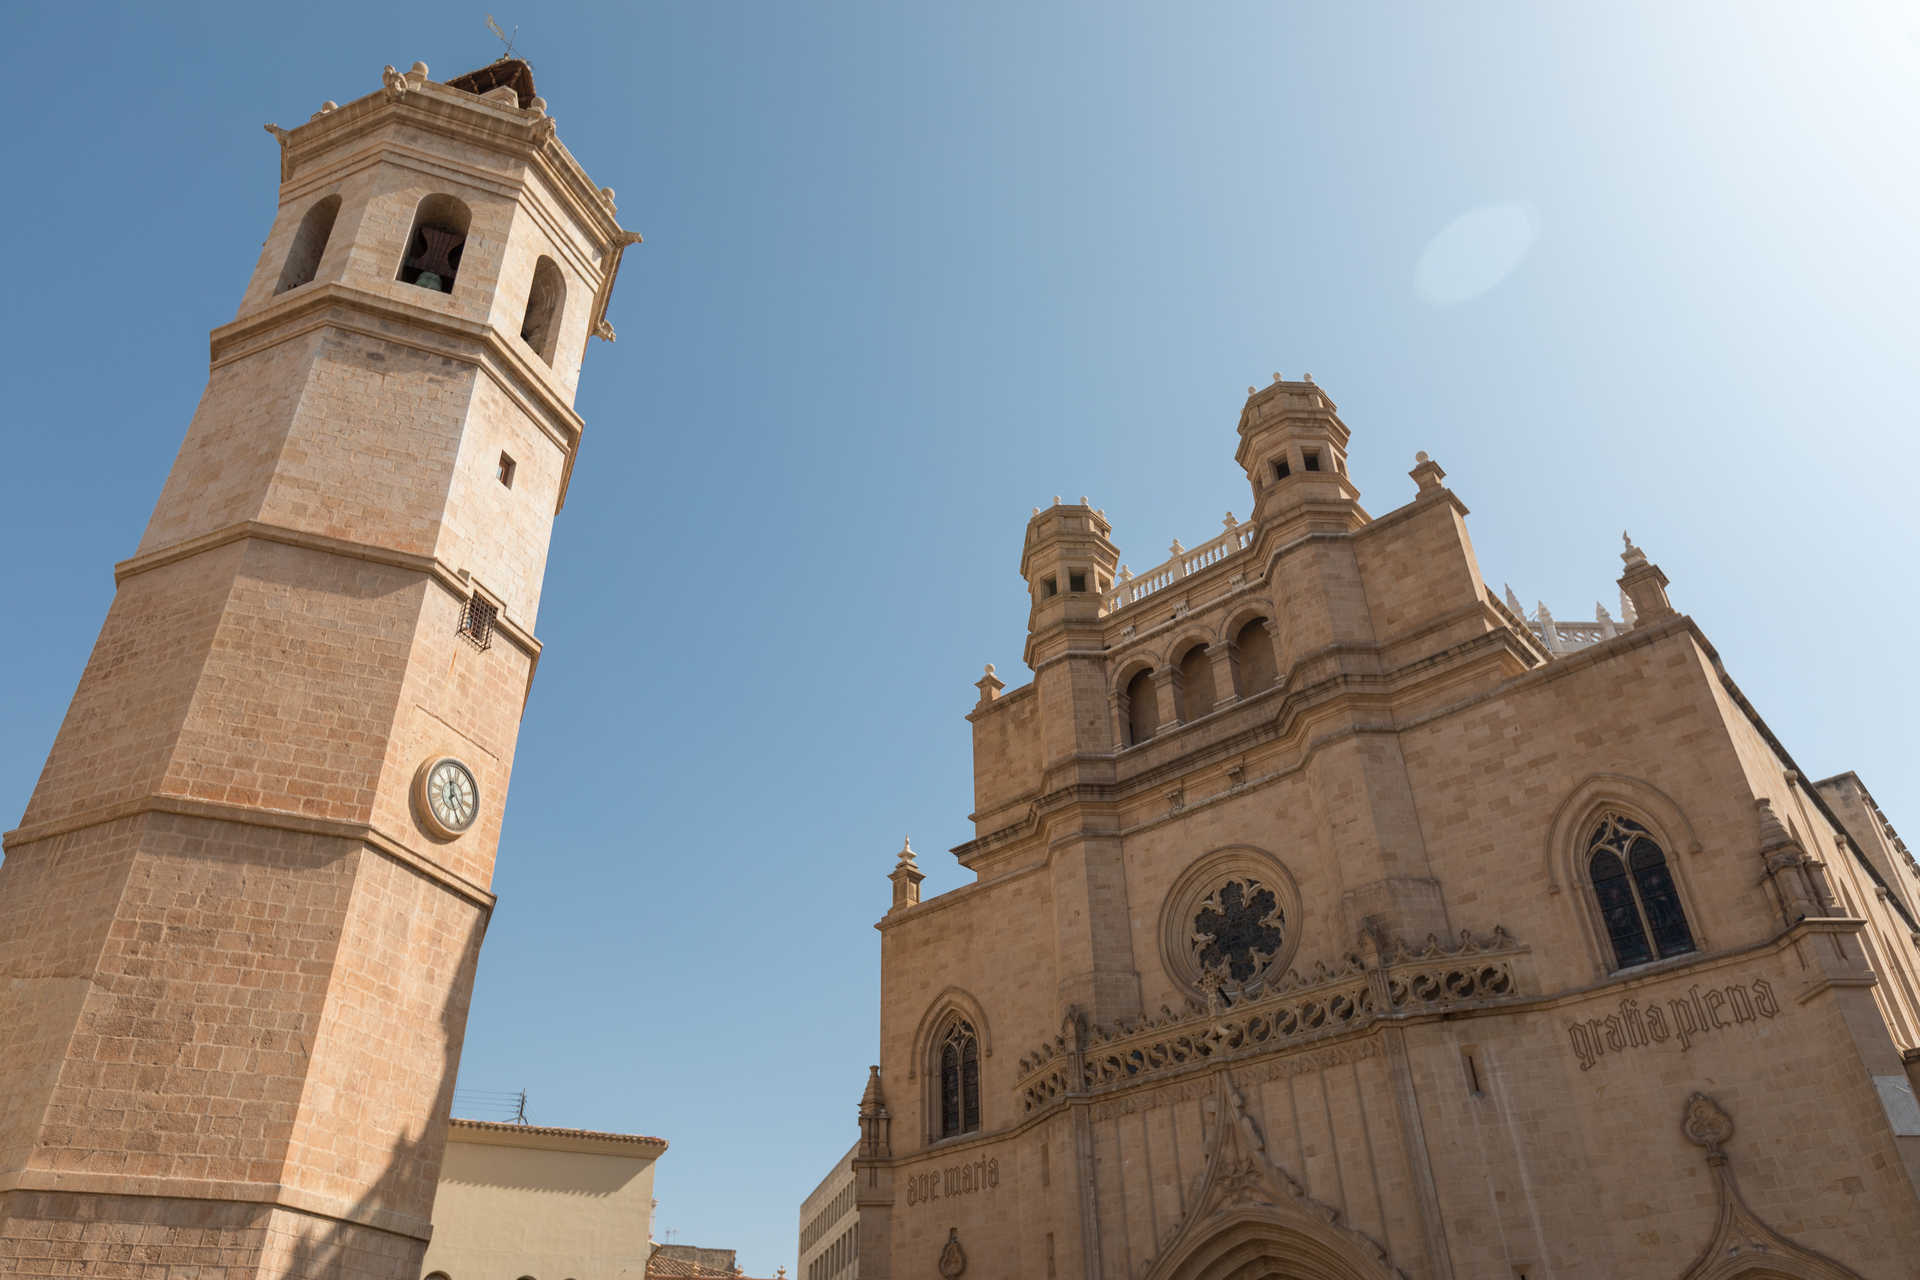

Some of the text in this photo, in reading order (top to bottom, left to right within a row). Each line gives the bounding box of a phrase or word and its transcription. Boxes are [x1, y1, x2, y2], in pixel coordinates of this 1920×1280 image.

[1569, 978, 1781, 1072] gratia plena
[907, 1153, 1000, 1207] ave maria
